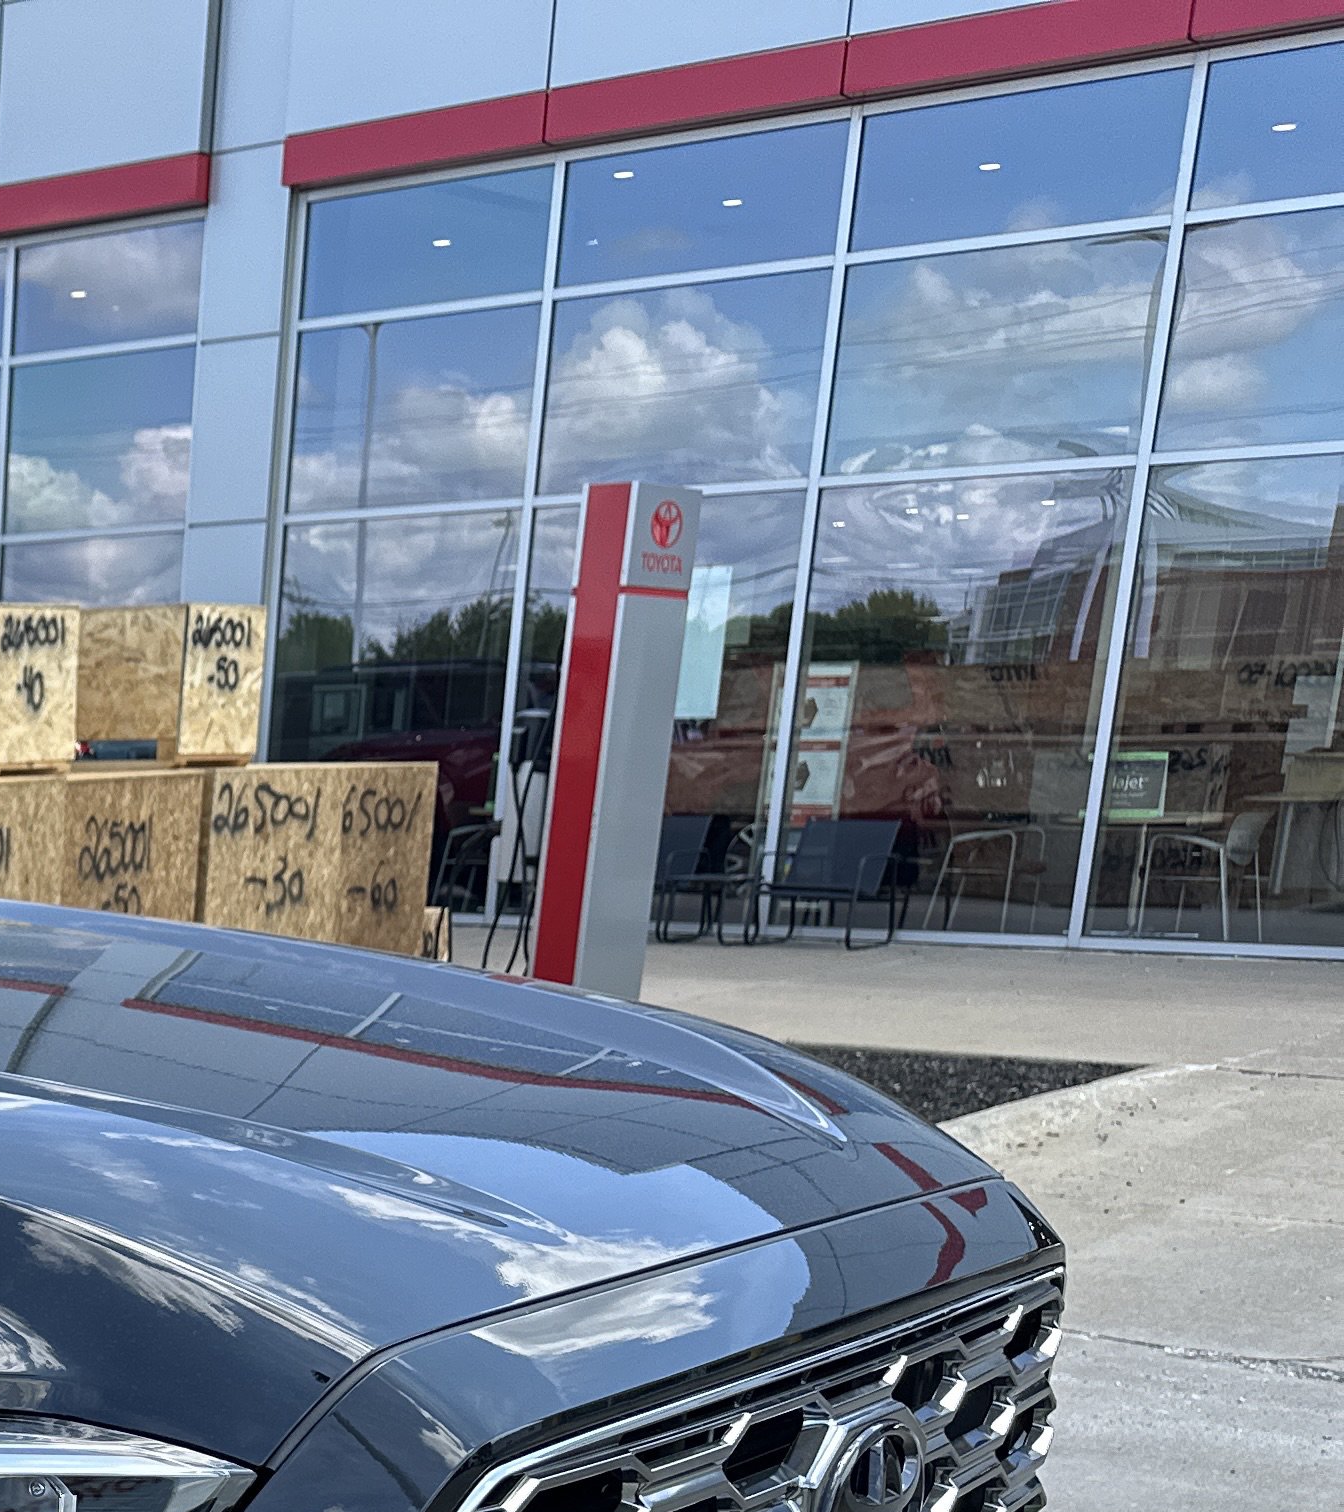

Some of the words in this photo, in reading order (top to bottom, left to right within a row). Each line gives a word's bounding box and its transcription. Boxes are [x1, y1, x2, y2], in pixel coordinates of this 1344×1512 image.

[641, 551, 683, 576] TOYOTA
[1, 614, 65, 653] 265001
[192, 614, 251, 649] 265001
[16, 665, 45, 713] -40
[207, 655, 241, 691] -50
[213, 783, 321, 841] 265001
[78, 814, 153, 881] 265001
[244, 854, 305, 917] -30
[346, 860, 398, 911] -60
